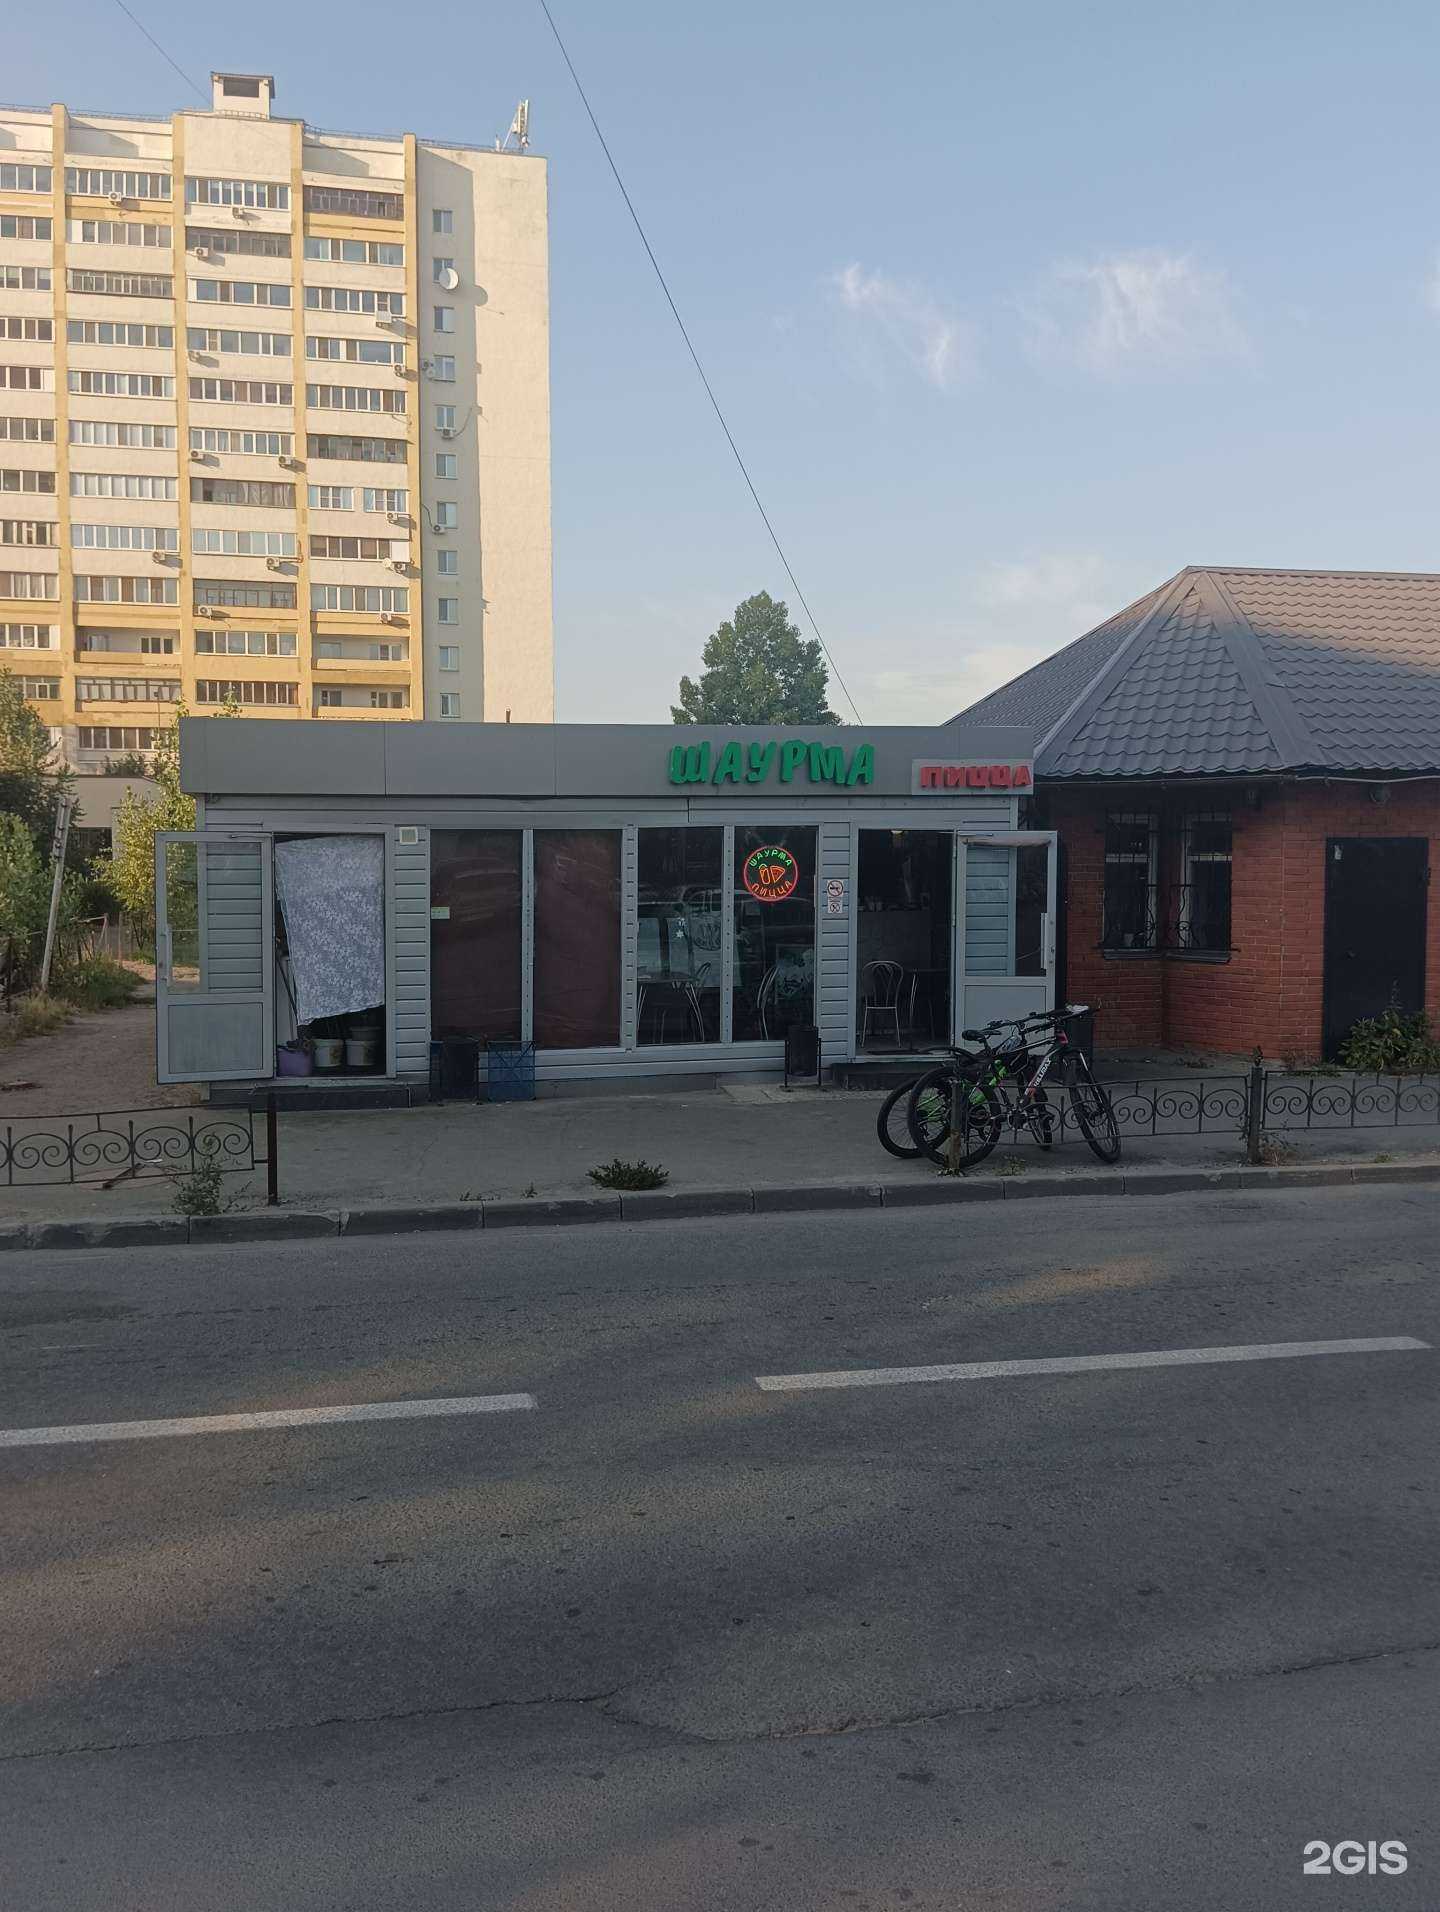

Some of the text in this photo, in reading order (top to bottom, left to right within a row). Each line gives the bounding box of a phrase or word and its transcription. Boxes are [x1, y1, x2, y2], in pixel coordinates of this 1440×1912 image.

[668, 740, 876, 786] ШАУРМА
[920, 765, 1033, 789] ПИЦЦА
[748, 849, 793, 868] ШАУРМА
[751, 880, 793, 899] ПИЦЦА
